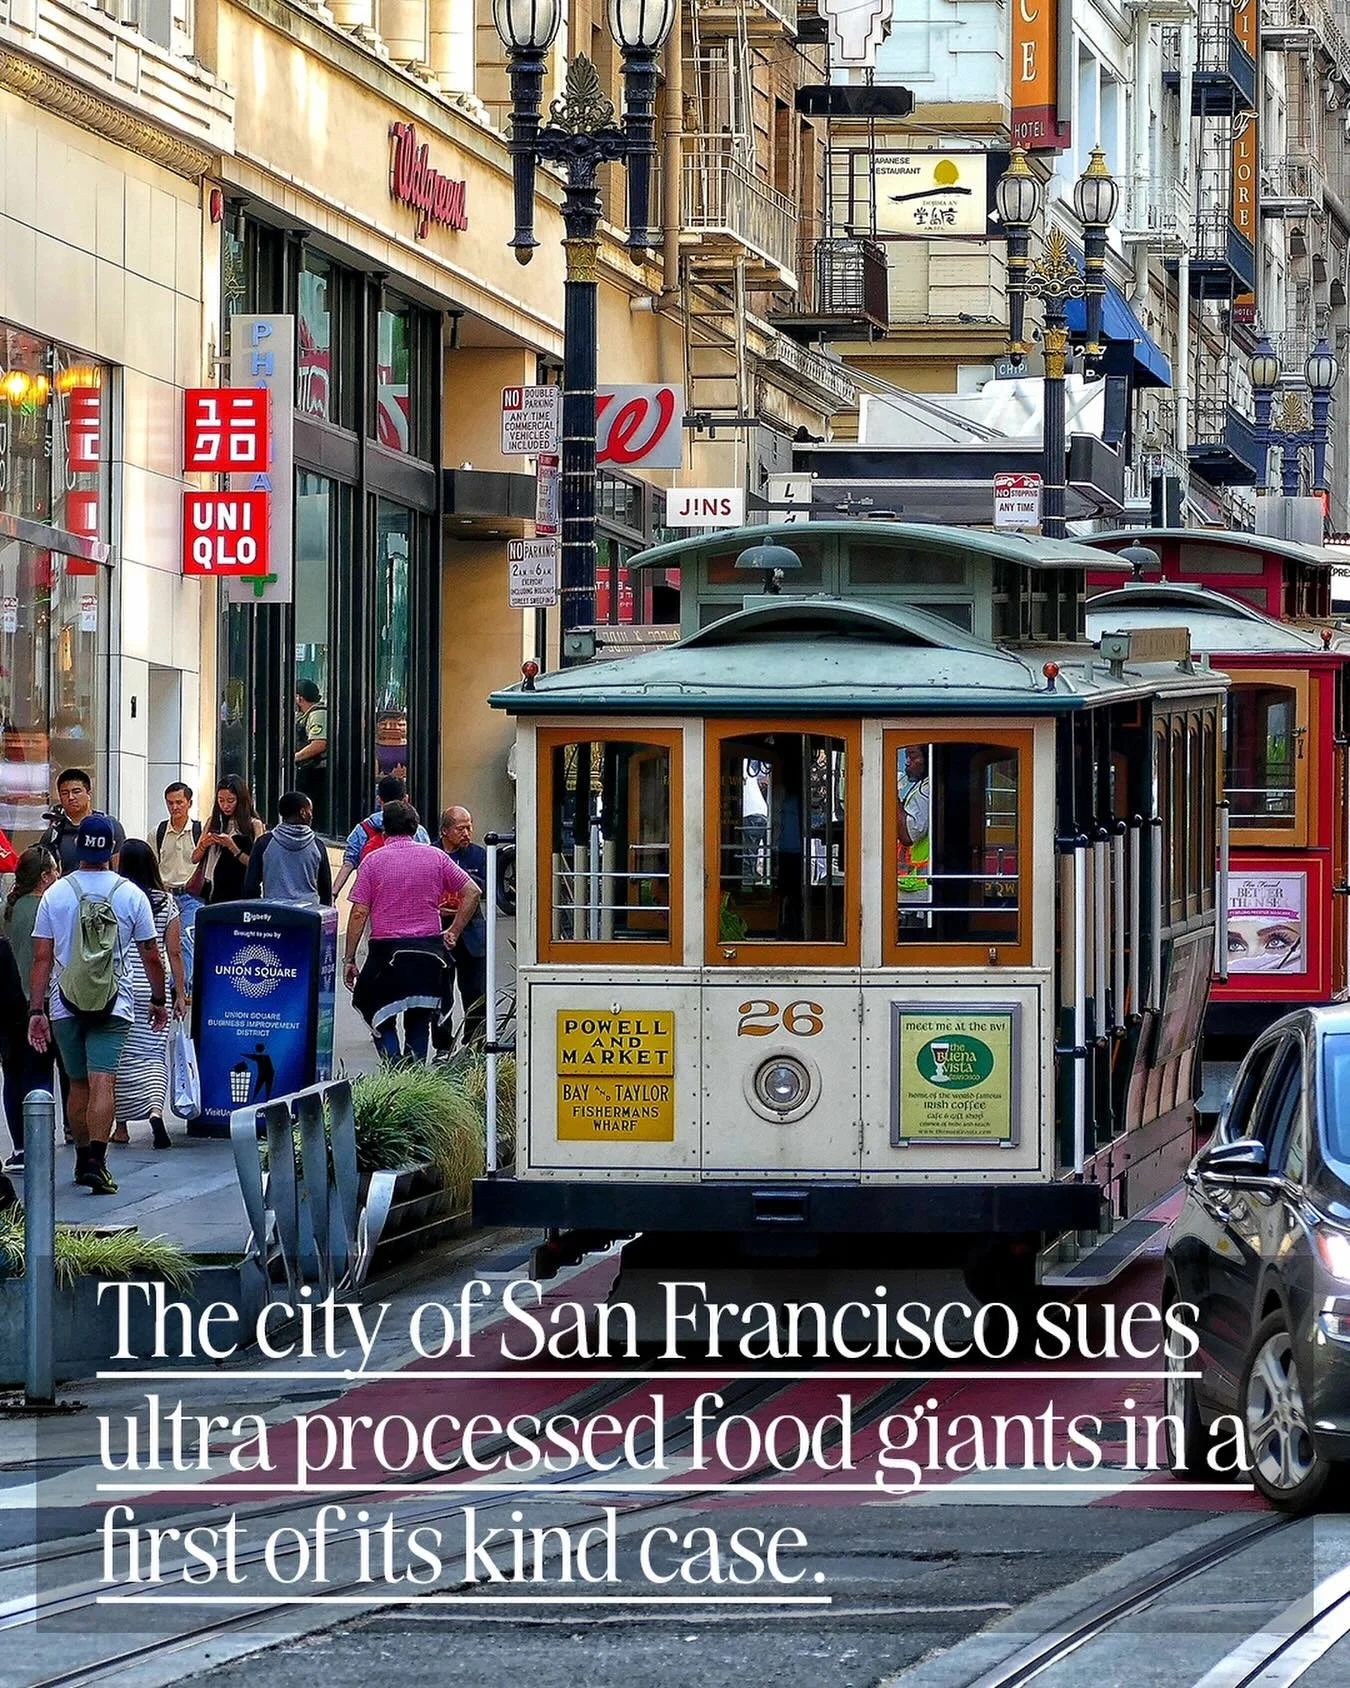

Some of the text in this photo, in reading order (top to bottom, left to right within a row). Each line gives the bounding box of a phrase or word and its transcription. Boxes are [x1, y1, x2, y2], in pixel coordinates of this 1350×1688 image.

[1014, 120, 1045, 139] HOTEL
[874, 157, 910, 165] APANESE
[874, 167, 921, 175] ESTAURANT
[392, 121, 469, 240] Walgreens
[504, 388, 554, 407] NO DOUBLE
[524, 399, 554, 408] PARKING
[195, 398, 257, 428] ユニ
[510, 411, 551, 422] ANY TIME
[504, 421, 555, 431] COMMERCIAL
[509, 430, 550, 441] VEHICLES
[193, 433, 257, 462] クロ
[509, 440, 550, 450] INCLUDED
[996, 489, 1038, 498] NO STOPPING
[999, 502, 1034, 512] ANY TIME
[192, 502, 252, 531] UNI
[192, 535, 258, 570] QLO
[510, 541, 555, 560] NO PARKING
[84, 834, 106, 848] MO
[215, 964, 297, 978] UNION SQUARE
[224, 1011, 280, 1021] UNION SQUARE
[738, 1000, 824, 1036] 26
[246, 1020, 300, 1030] IMPROVEMENT
[565, 1020, 667, 1035] POWELL
[236, 1028, 270, 1037] DISTRICT
[592, 1037, 641, 1048] AND
[562, 1050, 668, 1065] MARKET
[563, 1084, 669, 1102] BAY AND TAYLOR
[573, 1106, 660, 1118] FISHERMANS
[593, 1119, 638, 1132] WHARF
